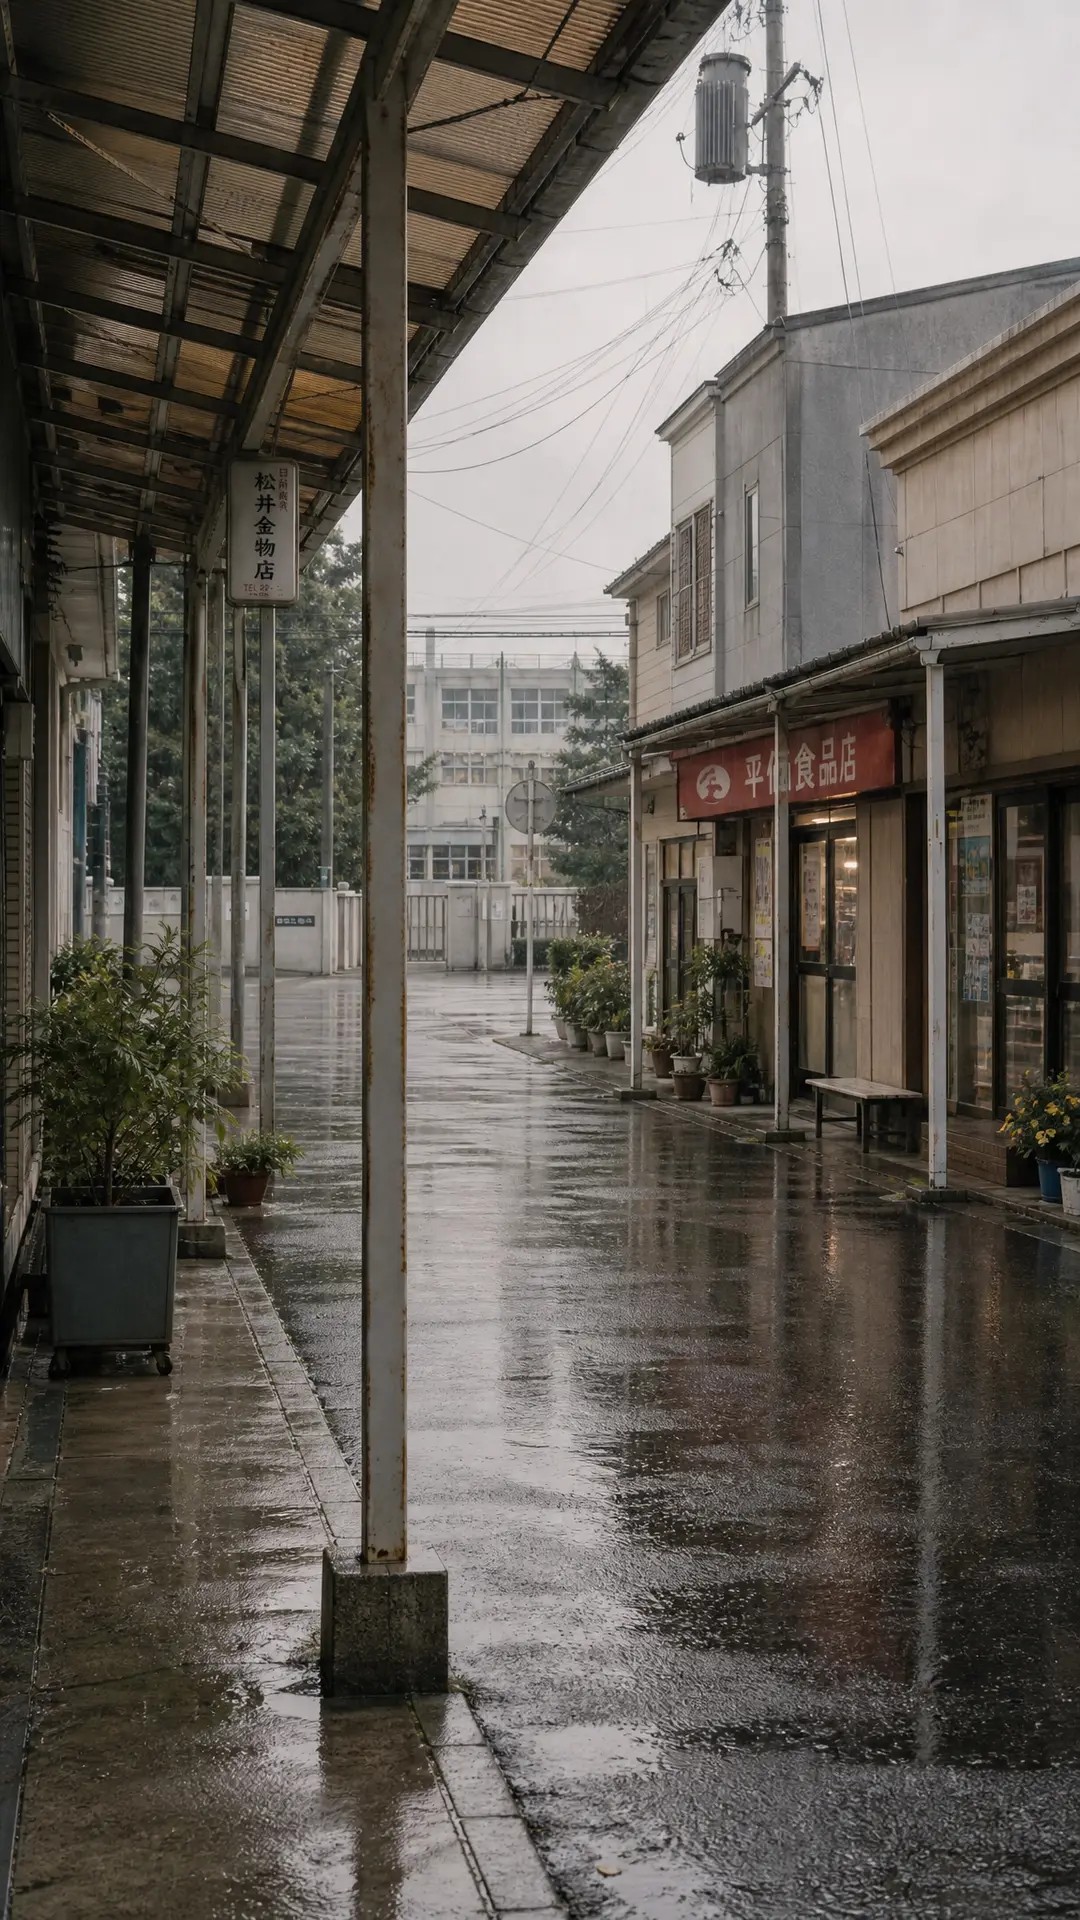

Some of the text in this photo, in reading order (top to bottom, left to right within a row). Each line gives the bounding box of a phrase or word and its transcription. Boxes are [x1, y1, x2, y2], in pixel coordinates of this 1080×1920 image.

[254, 472, 276, 580] 松井金物店
[243, 584, 257, 592] TEL
